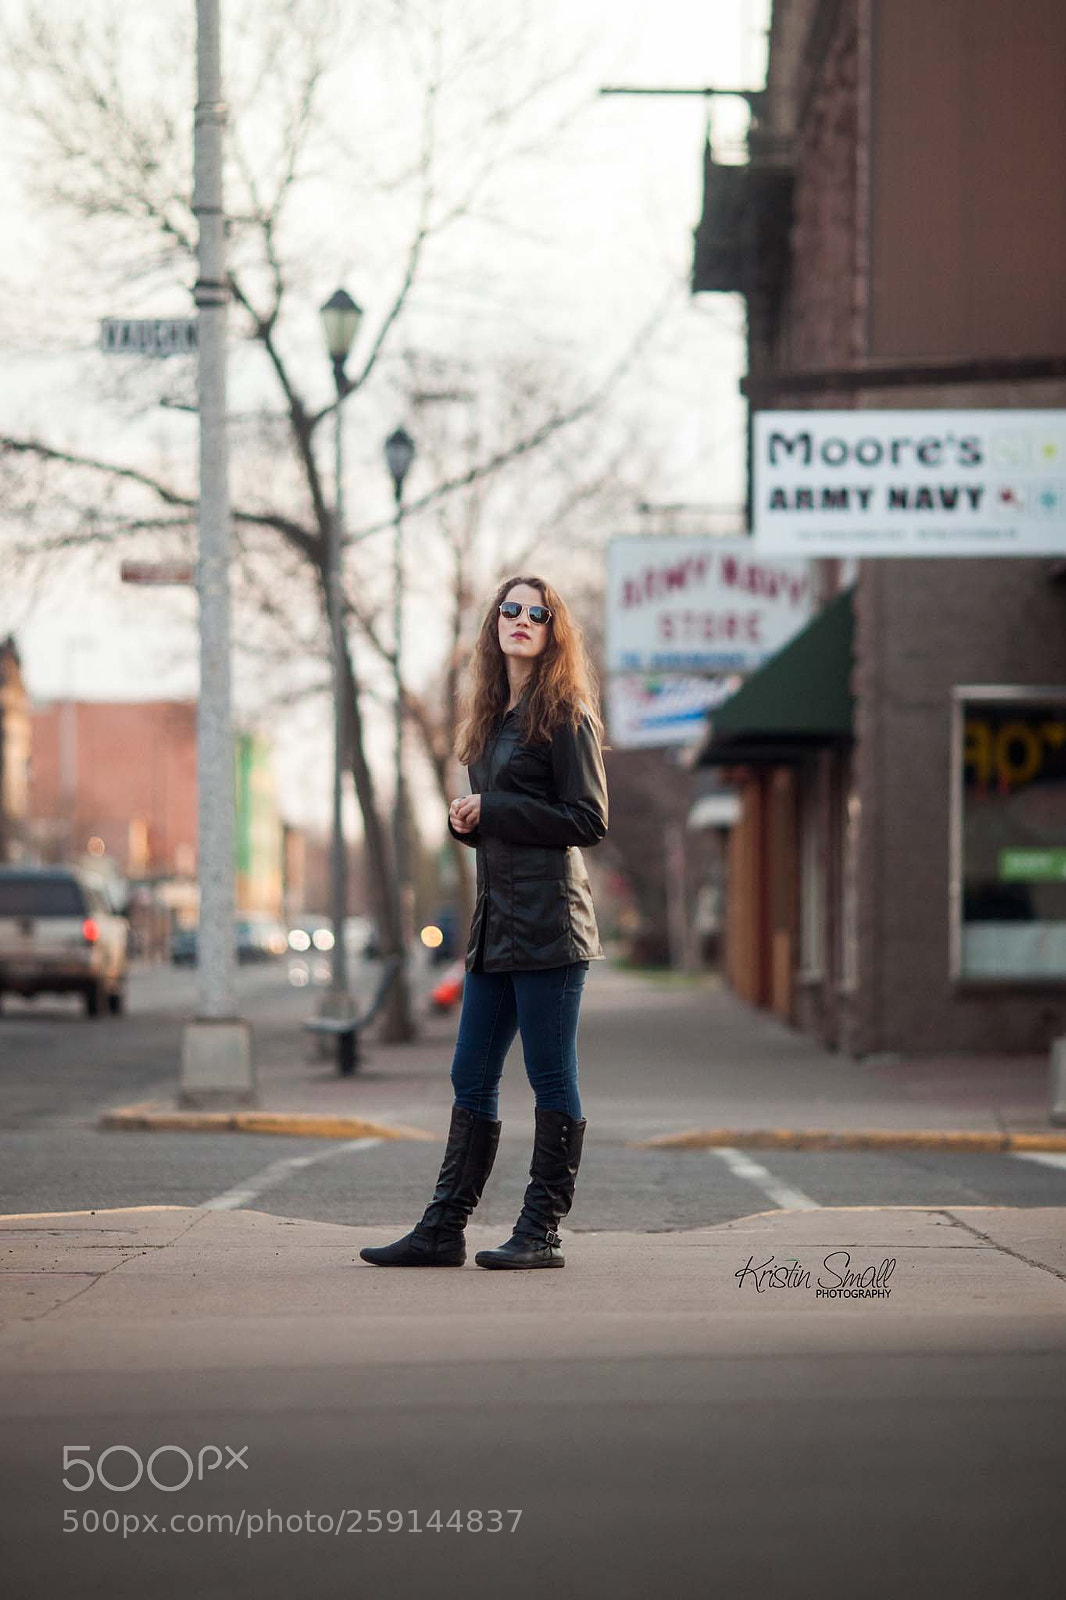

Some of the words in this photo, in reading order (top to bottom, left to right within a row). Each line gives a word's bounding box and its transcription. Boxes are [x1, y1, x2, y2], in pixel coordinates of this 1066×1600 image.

[768, 429, 985, 468] Moore's
[768, 485, 873, 511] ARMY
[887, 484, 984, 511] NAVY
